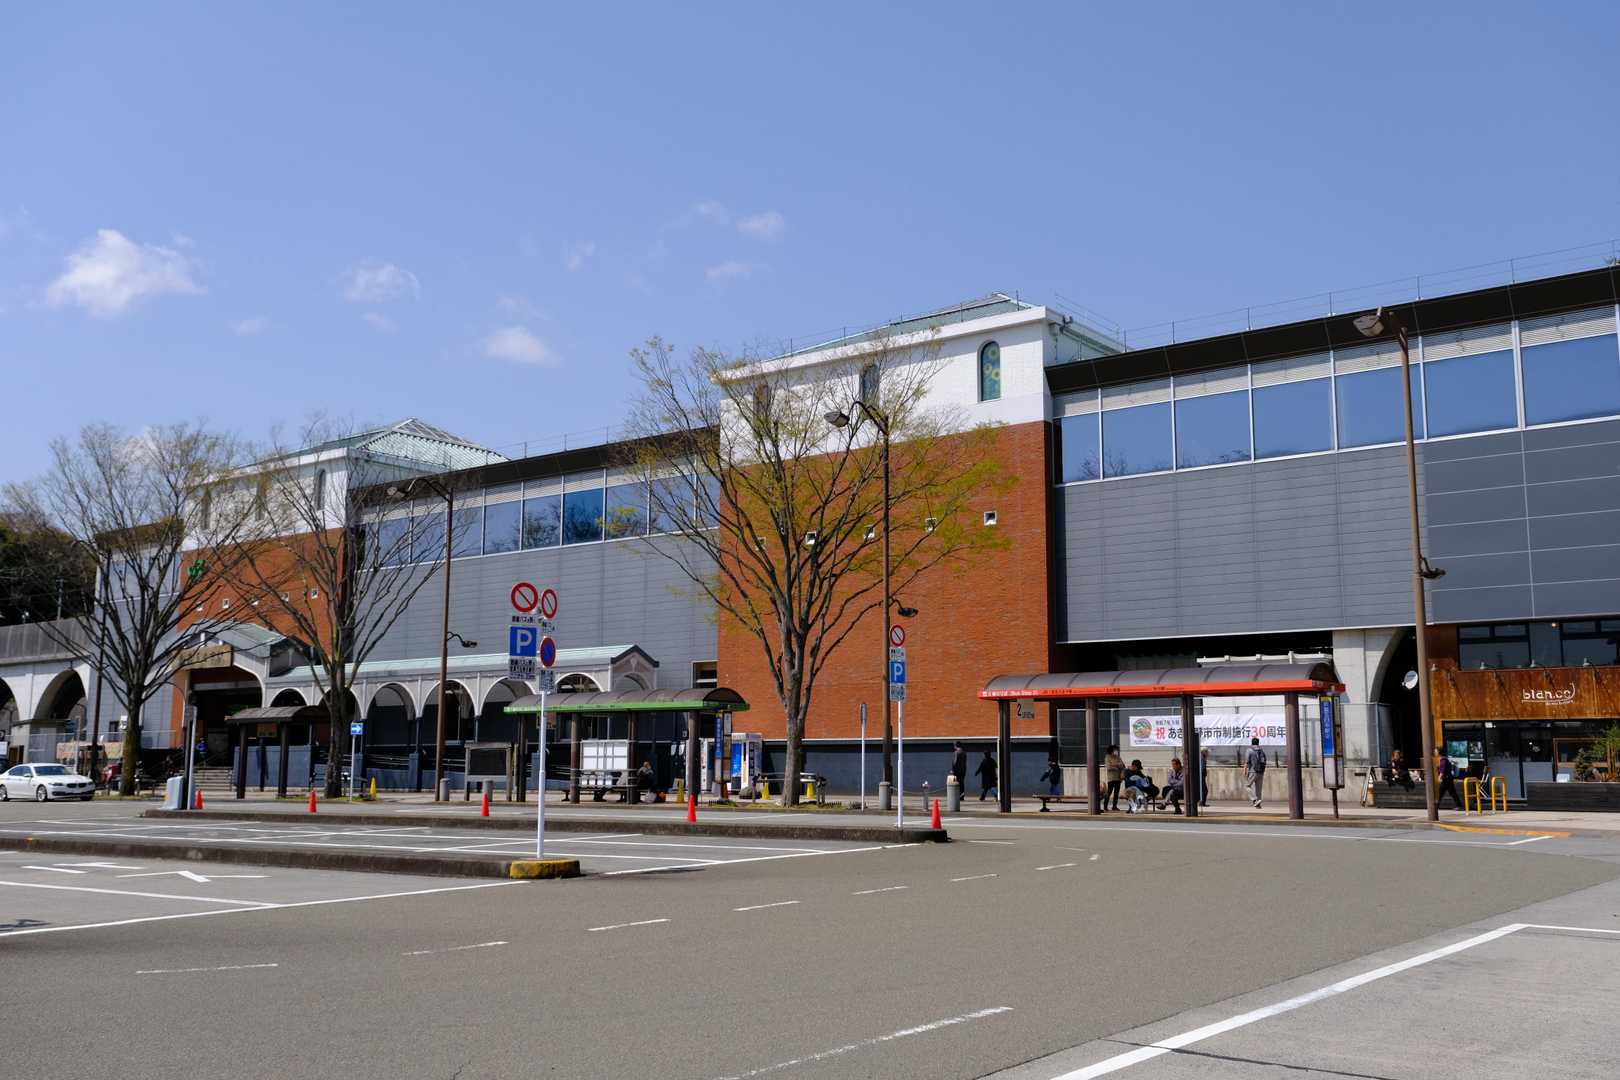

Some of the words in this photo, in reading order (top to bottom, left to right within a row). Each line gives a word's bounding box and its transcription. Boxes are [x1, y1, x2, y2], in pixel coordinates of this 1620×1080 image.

[516, 629, 532, 655] P
[893, 662, 904, 682] P
[1017, 703, 1022, 717] 2
[1156, 727, 1166, 740] 祝
